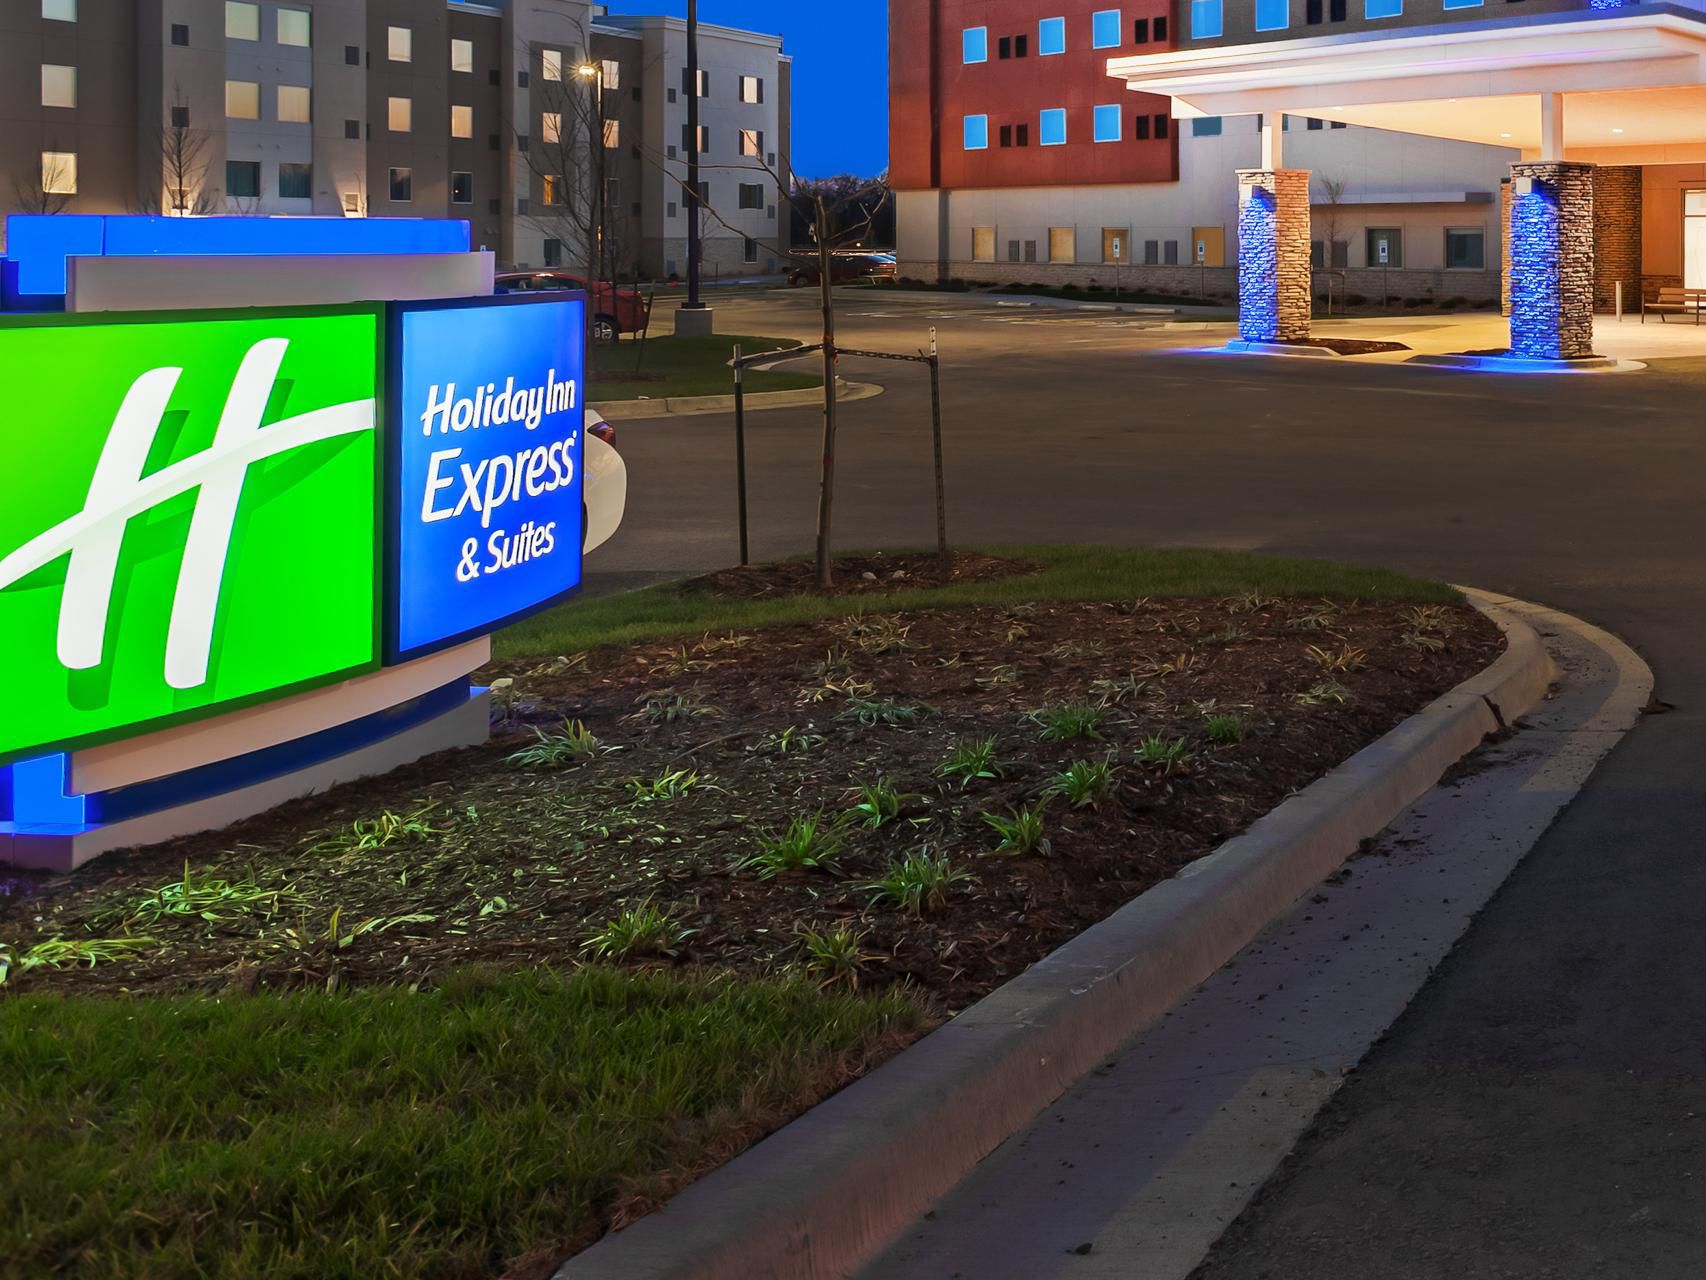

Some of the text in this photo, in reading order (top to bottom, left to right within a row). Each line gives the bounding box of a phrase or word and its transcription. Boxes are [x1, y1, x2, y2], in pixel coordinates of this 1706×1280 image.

[420, 368, 576, 436] Holiday Inn
[421, 436, 577, 528] Express
[456, 520, 556, 582] & Suites
